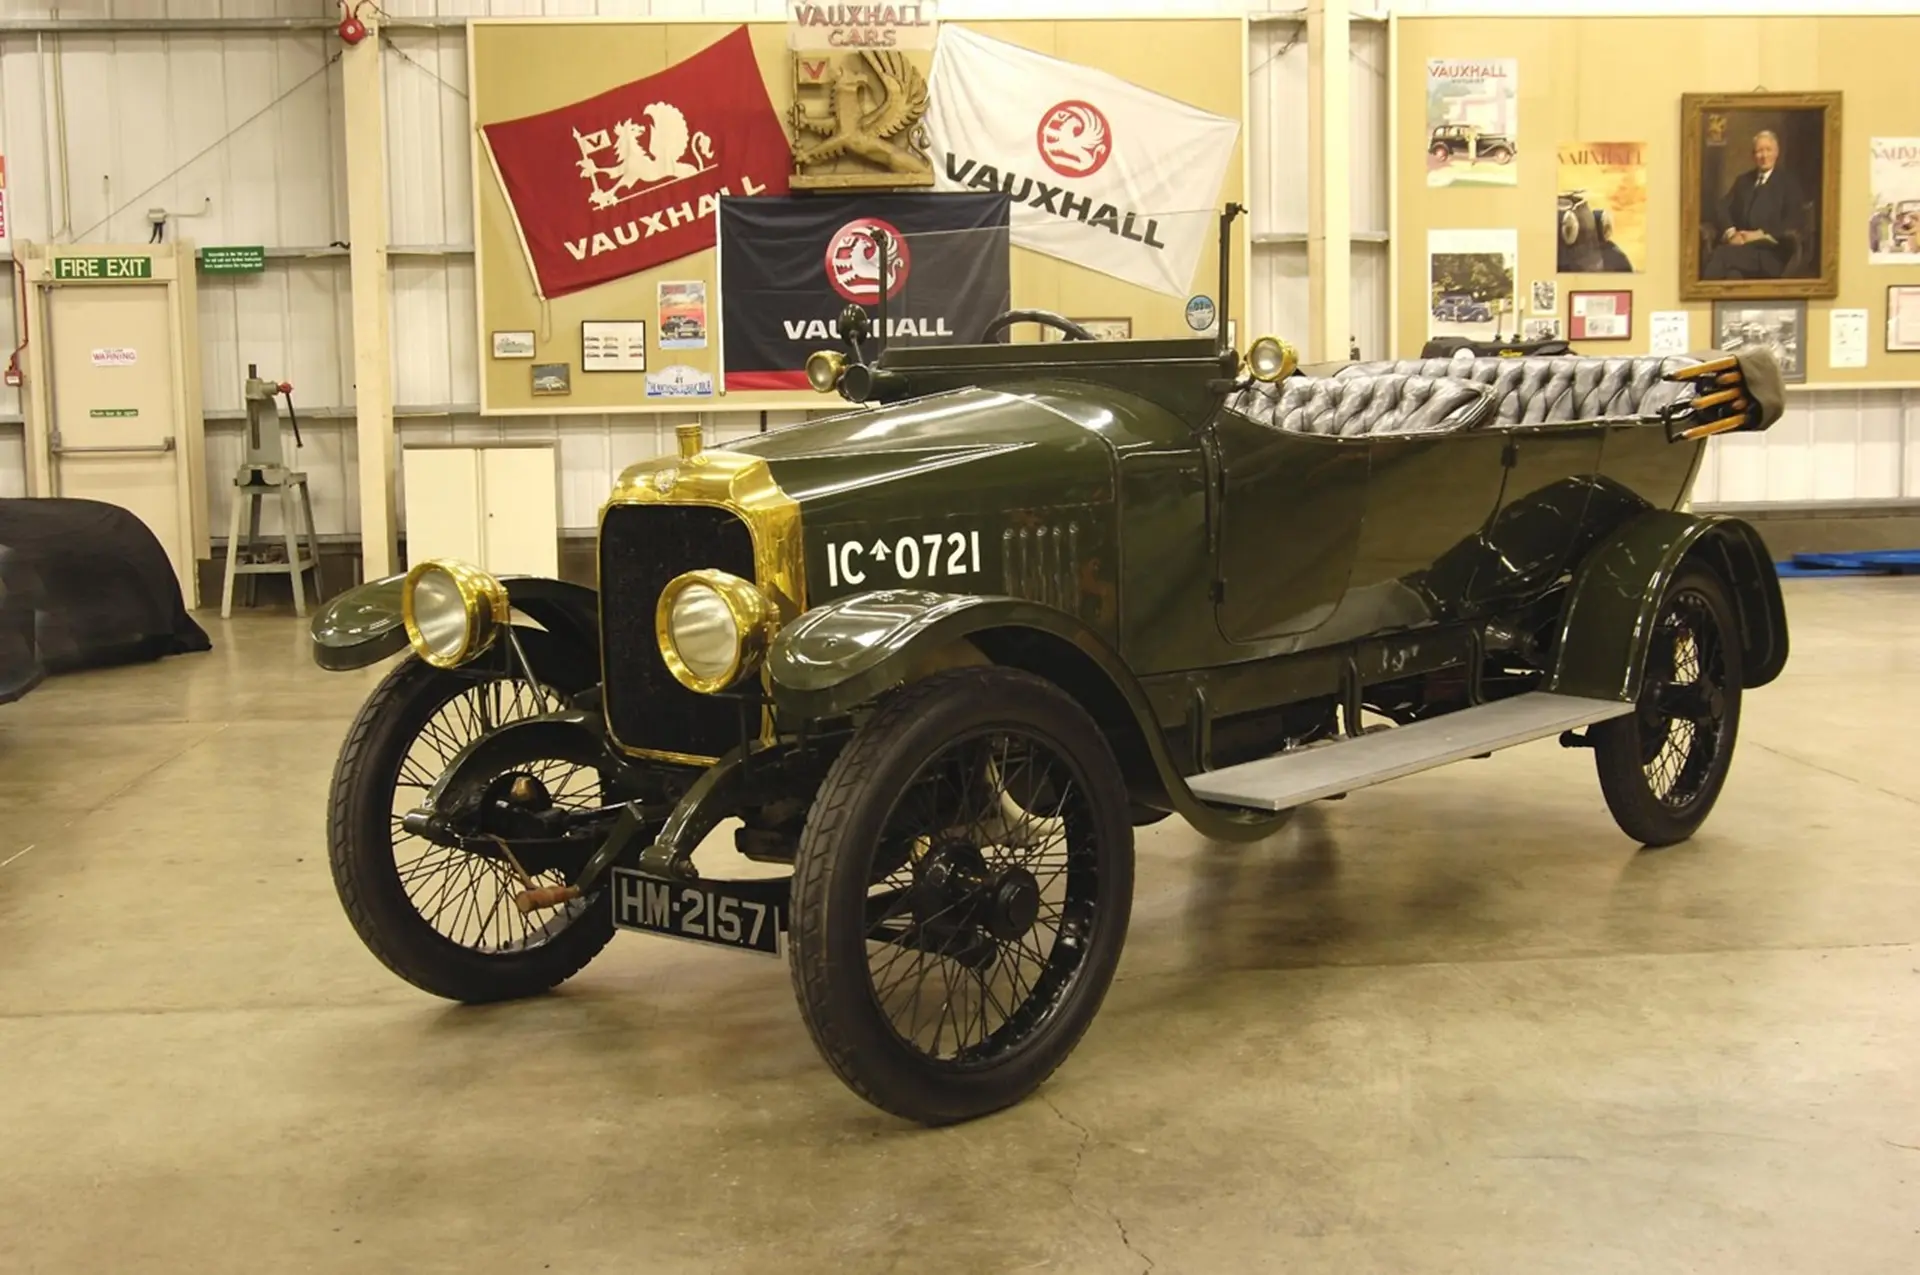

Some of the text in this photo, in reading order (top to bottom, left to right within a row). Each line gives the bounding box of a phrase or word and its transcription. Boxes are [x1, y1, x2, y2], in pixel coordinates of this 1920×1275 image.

[794, 4, 931, 27] VAUXHALL
[828, 29, 897, 47] CARS
[802, 60, 827, 80] V
[1427, 64, 1508, 78] VAUXHALL
[945, 152, 1165, 250] VAUXHALL
[564, 176, 766, 261] VAUXHAL
[60, 258, 145, 277] FIRE EXIT
[895, 530, 981, 579] 0721
